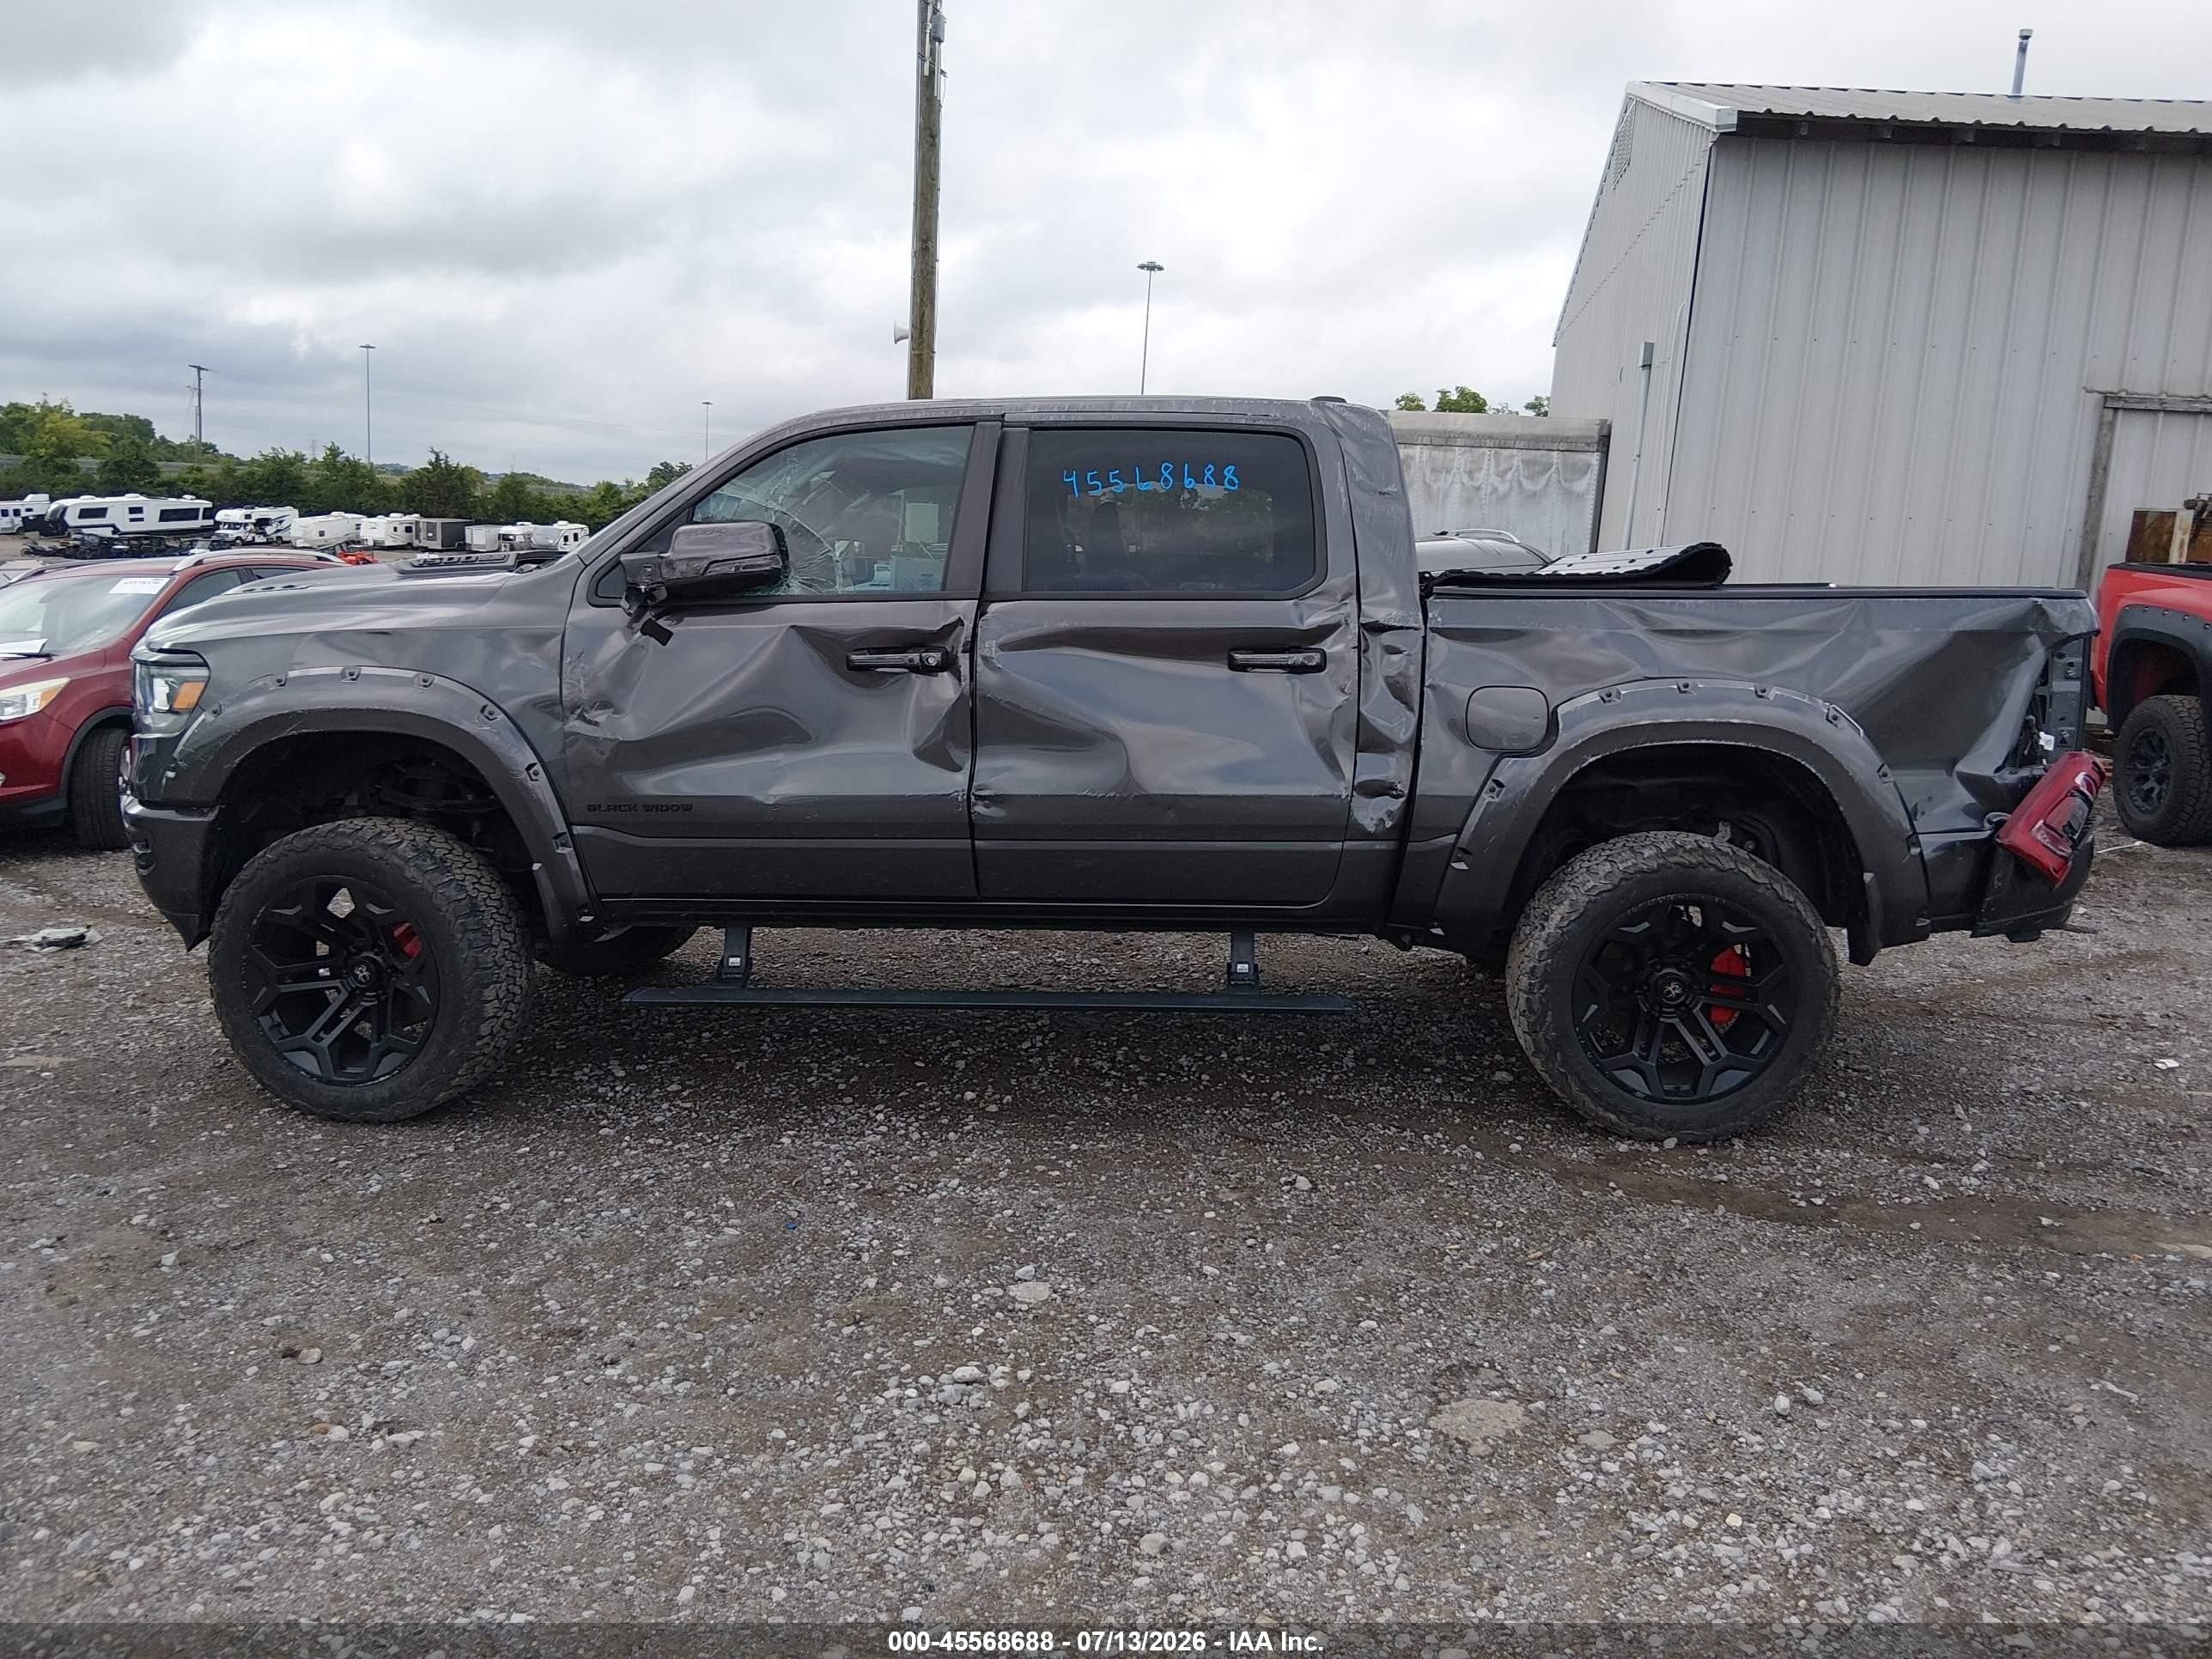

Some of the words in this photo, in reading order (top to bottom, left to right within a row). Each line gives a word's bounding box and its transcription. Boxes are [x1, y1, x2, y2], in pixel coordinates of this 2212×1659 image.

[1062, 461, 1240, 498] 45568688
[586, 803, 639, 812] BLACK
[642, 803, 694, 812] WIDOW
